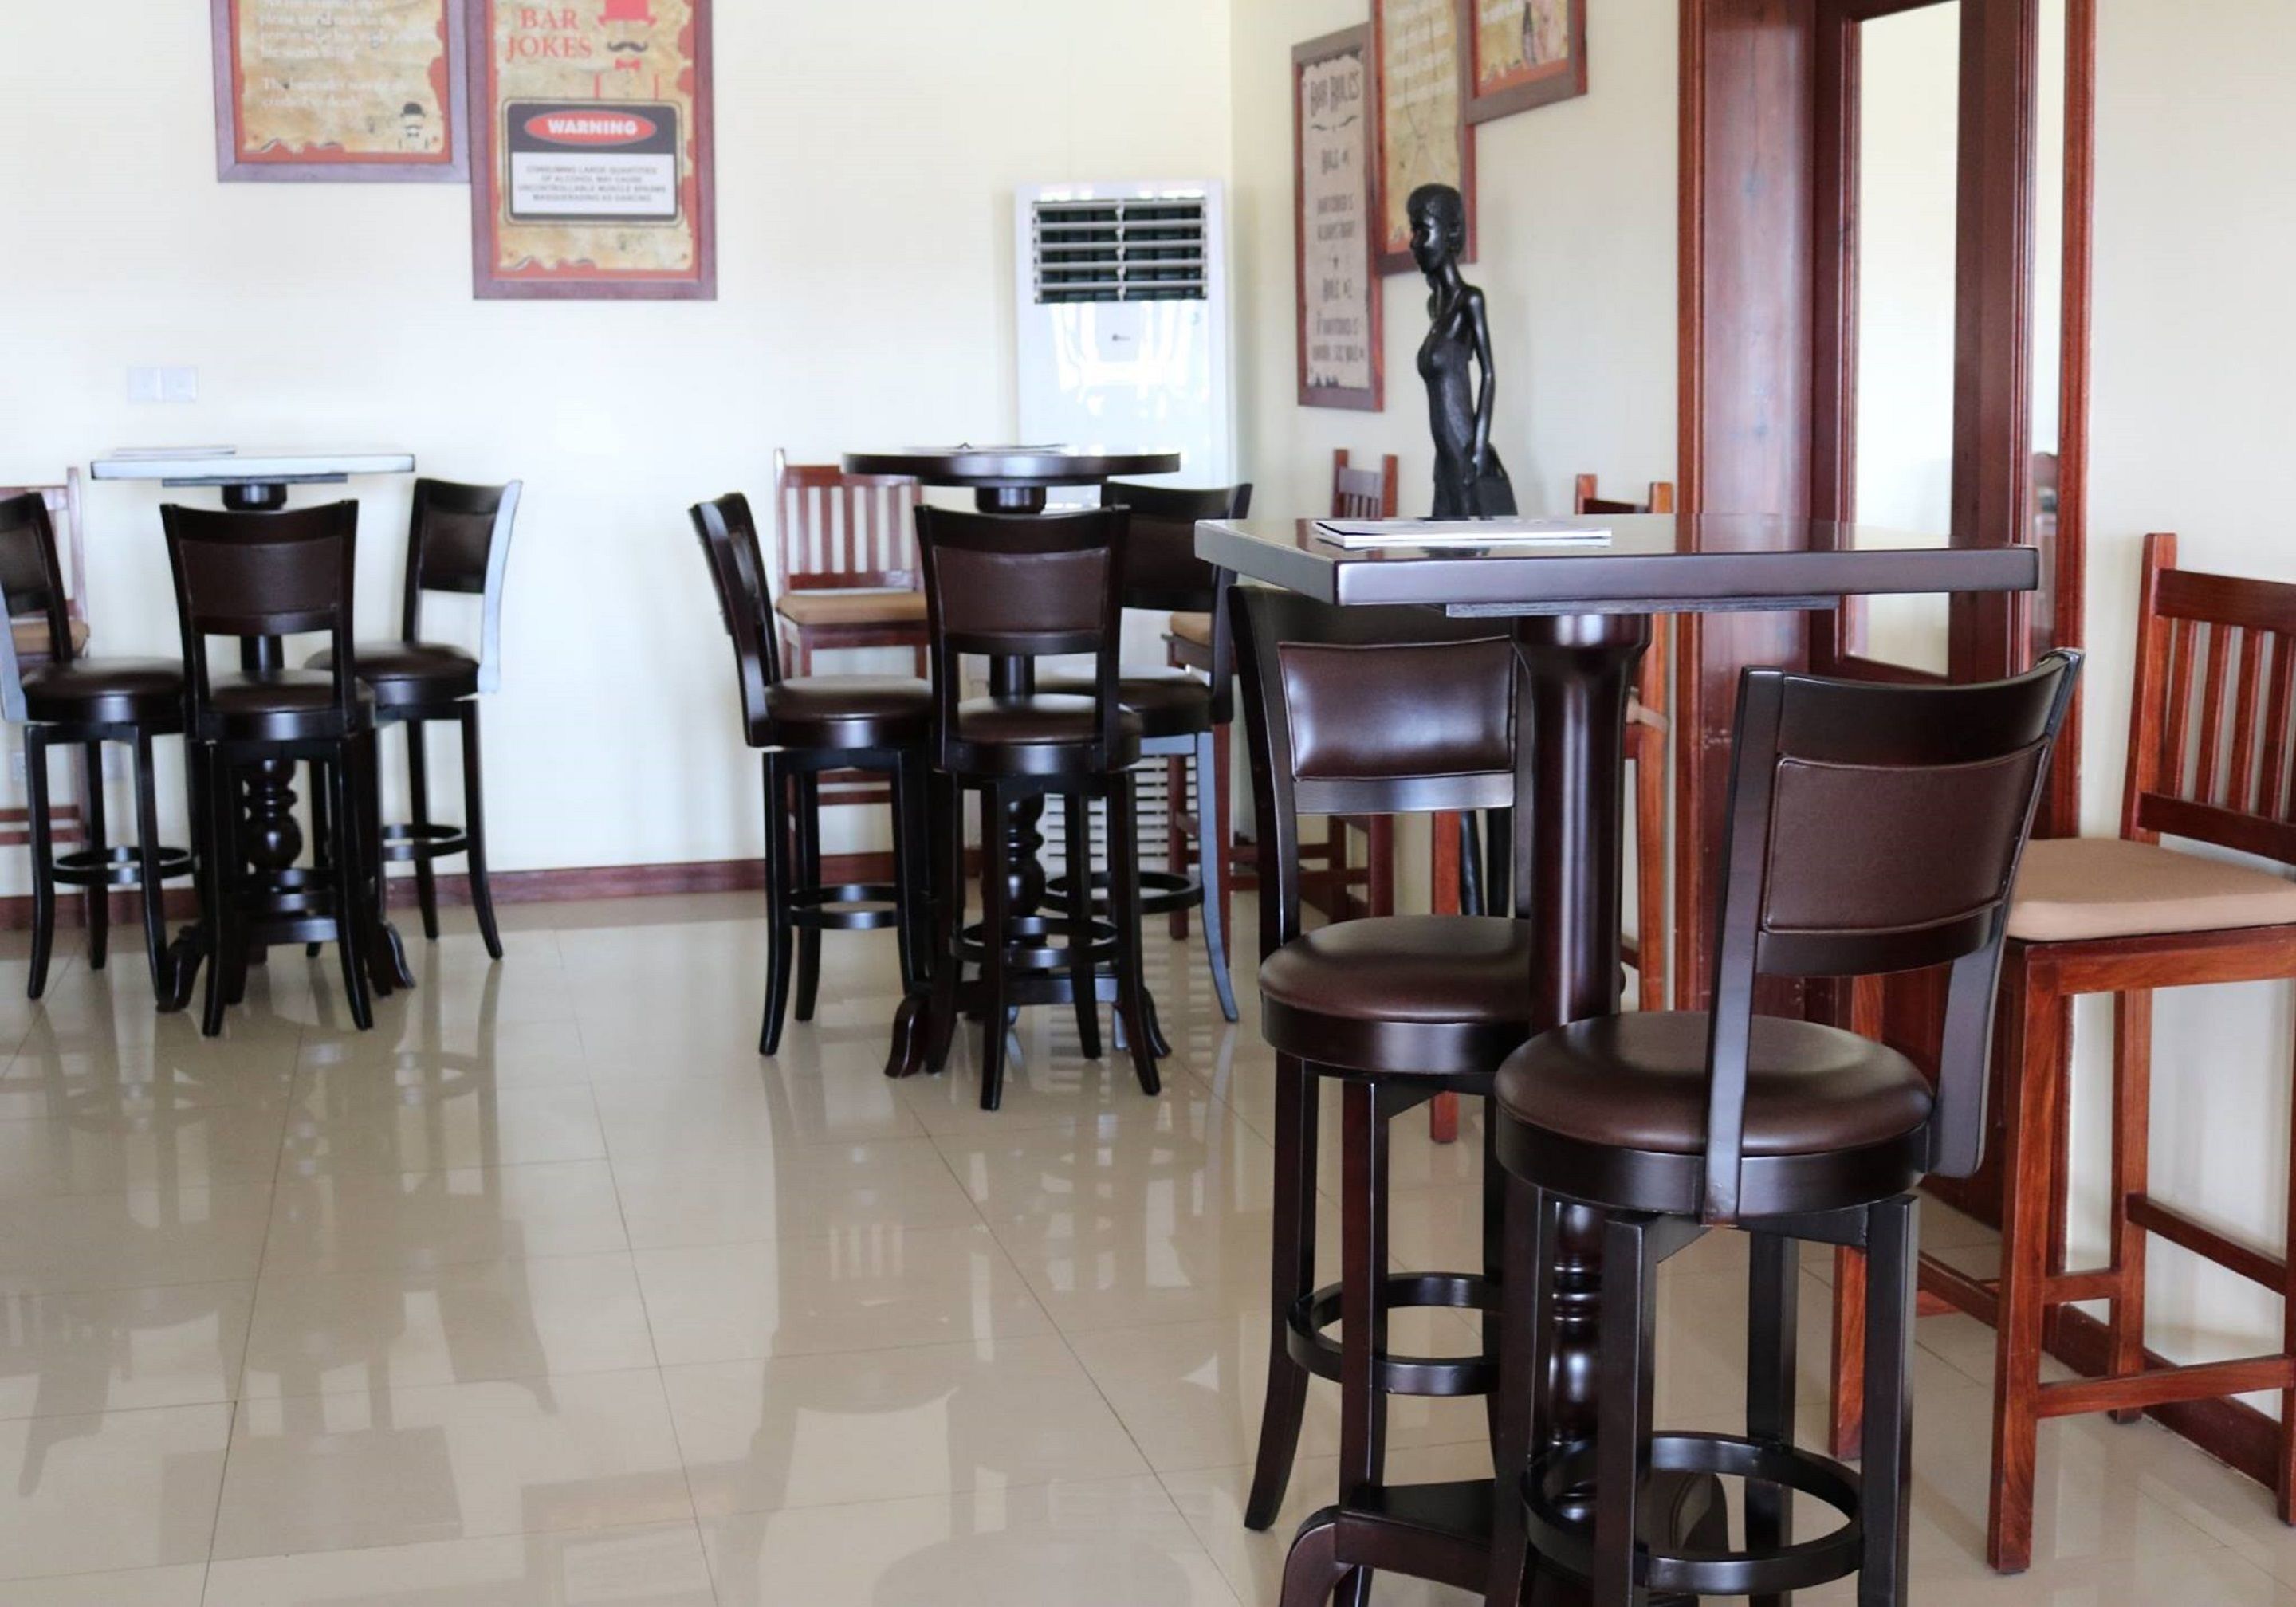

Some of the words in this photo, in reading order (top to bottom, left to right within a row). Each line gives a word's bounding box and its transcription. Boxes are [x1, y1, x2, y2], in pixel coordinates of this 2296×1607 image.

[520, 8, 579, 29] BAR
[505, 37, 592, 64] JOKES
[547, 118, 638, 135] WARNING
